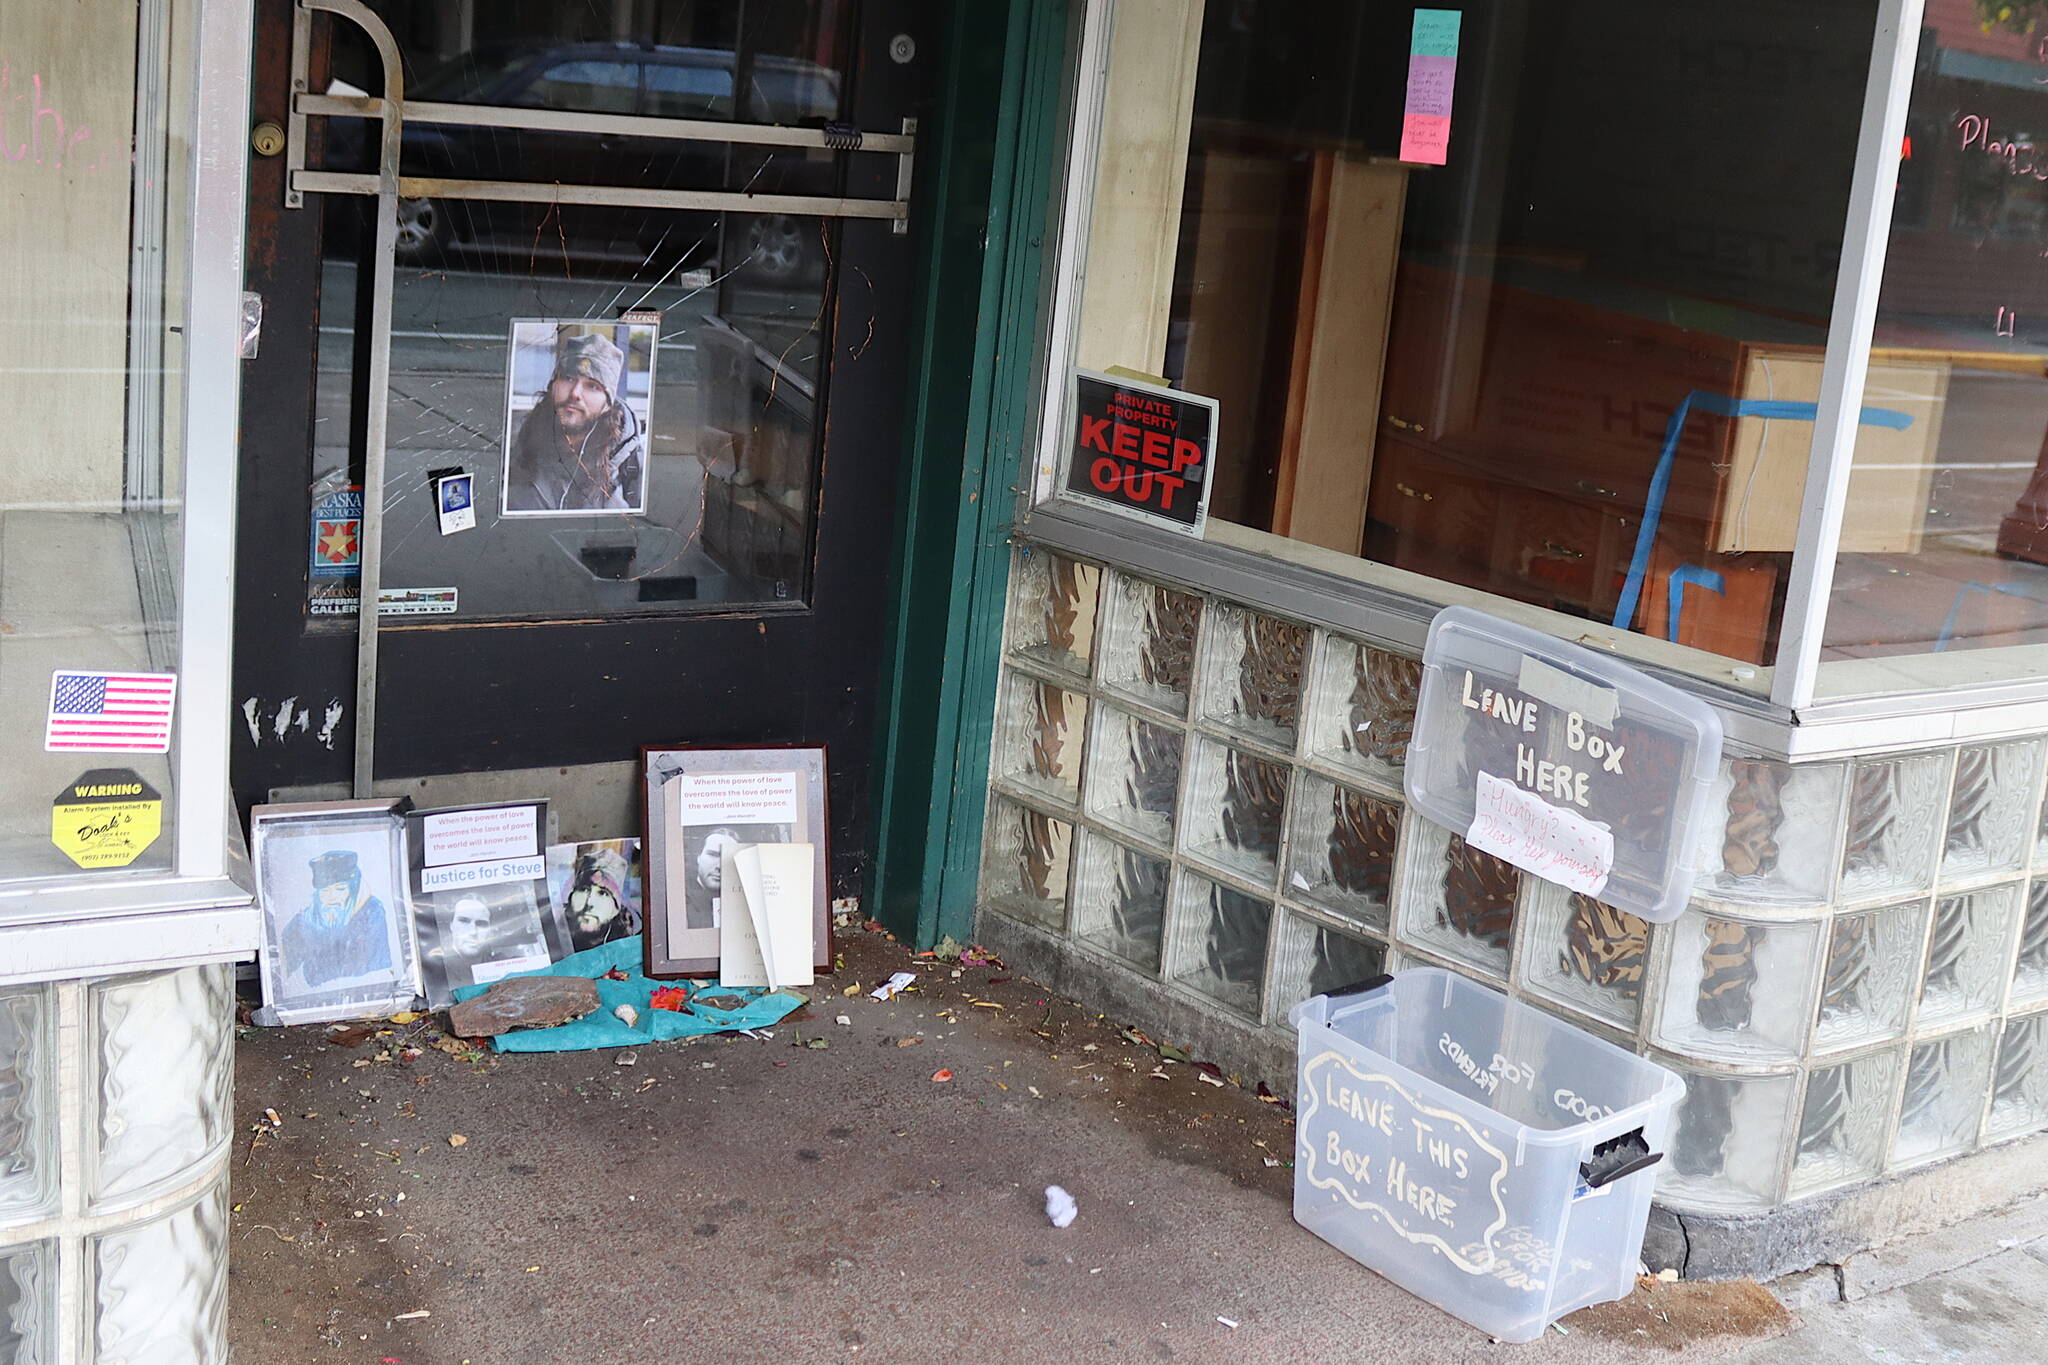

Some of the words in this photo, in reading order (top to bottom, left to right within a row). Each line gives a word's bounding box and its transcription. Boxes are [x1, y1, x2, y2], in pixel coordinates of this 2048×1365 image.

[1114, 392, 1172, 416] PRIVATE
[1106, 404, 1178, 431] PROPERTY
[1080, 414, 1201, 472] KEEP
[1089, 457, 1185, 511] OUT
[310, 605, 360, 615] GALLER
[1462, 670, 1537, 732] LEAVE
[718, 777, 731, 785] the
[732, 777, 756, 787] power
[757, 776, 765, 784] of
[766, 776, 782, 784] love
[1516, 743, 1589, 808] HERE
[75, 783, 143, 798] WARNING
[684, 790, 727, 799] overcomes
[728, 789, 741, 797] the
[742, 788, 758, 796] love
[759, 788, 767, 796] of
[768, 787, 793, 797] power
[85, 806, 110, 814] System
[142, 803, 151, 811] By
[688, 802, 701, 810] the
[703, 801, 725, 810] world
[726, 800, 740, 808] will
[741, 800, 761, 808] know
[763, 800, 788, 809] peace.
[1491, 783, 1560, 846] Hungry?
[438, 815, 460, 825] When
[461, 815, 473, 823] the
[474, 813, 498, 823] power
[499, 811, 508, 819] of
[509, 810, 524, 818] love
[429, 829, 469, 840] overcomes
[470, 826, 483, 834] the
[484, 825, 500, 833] love
[510, 822, 535, 831] power
[433, 843, 445, 851] the
[447, 841, 468, 849] world
[484, 837, 503, 845] know
[505, 834, 528, 843] peace.
[424, 870, 476, 885] Justice
[479, 866, 499, 879] for
[502, 863, 542, 877] Steve
[1326, 1072, 1394, 1136] LEAVE
[1411, 1118, 1468, 1179] THIS
[1387, 1156, 1457, 1229] HERE
